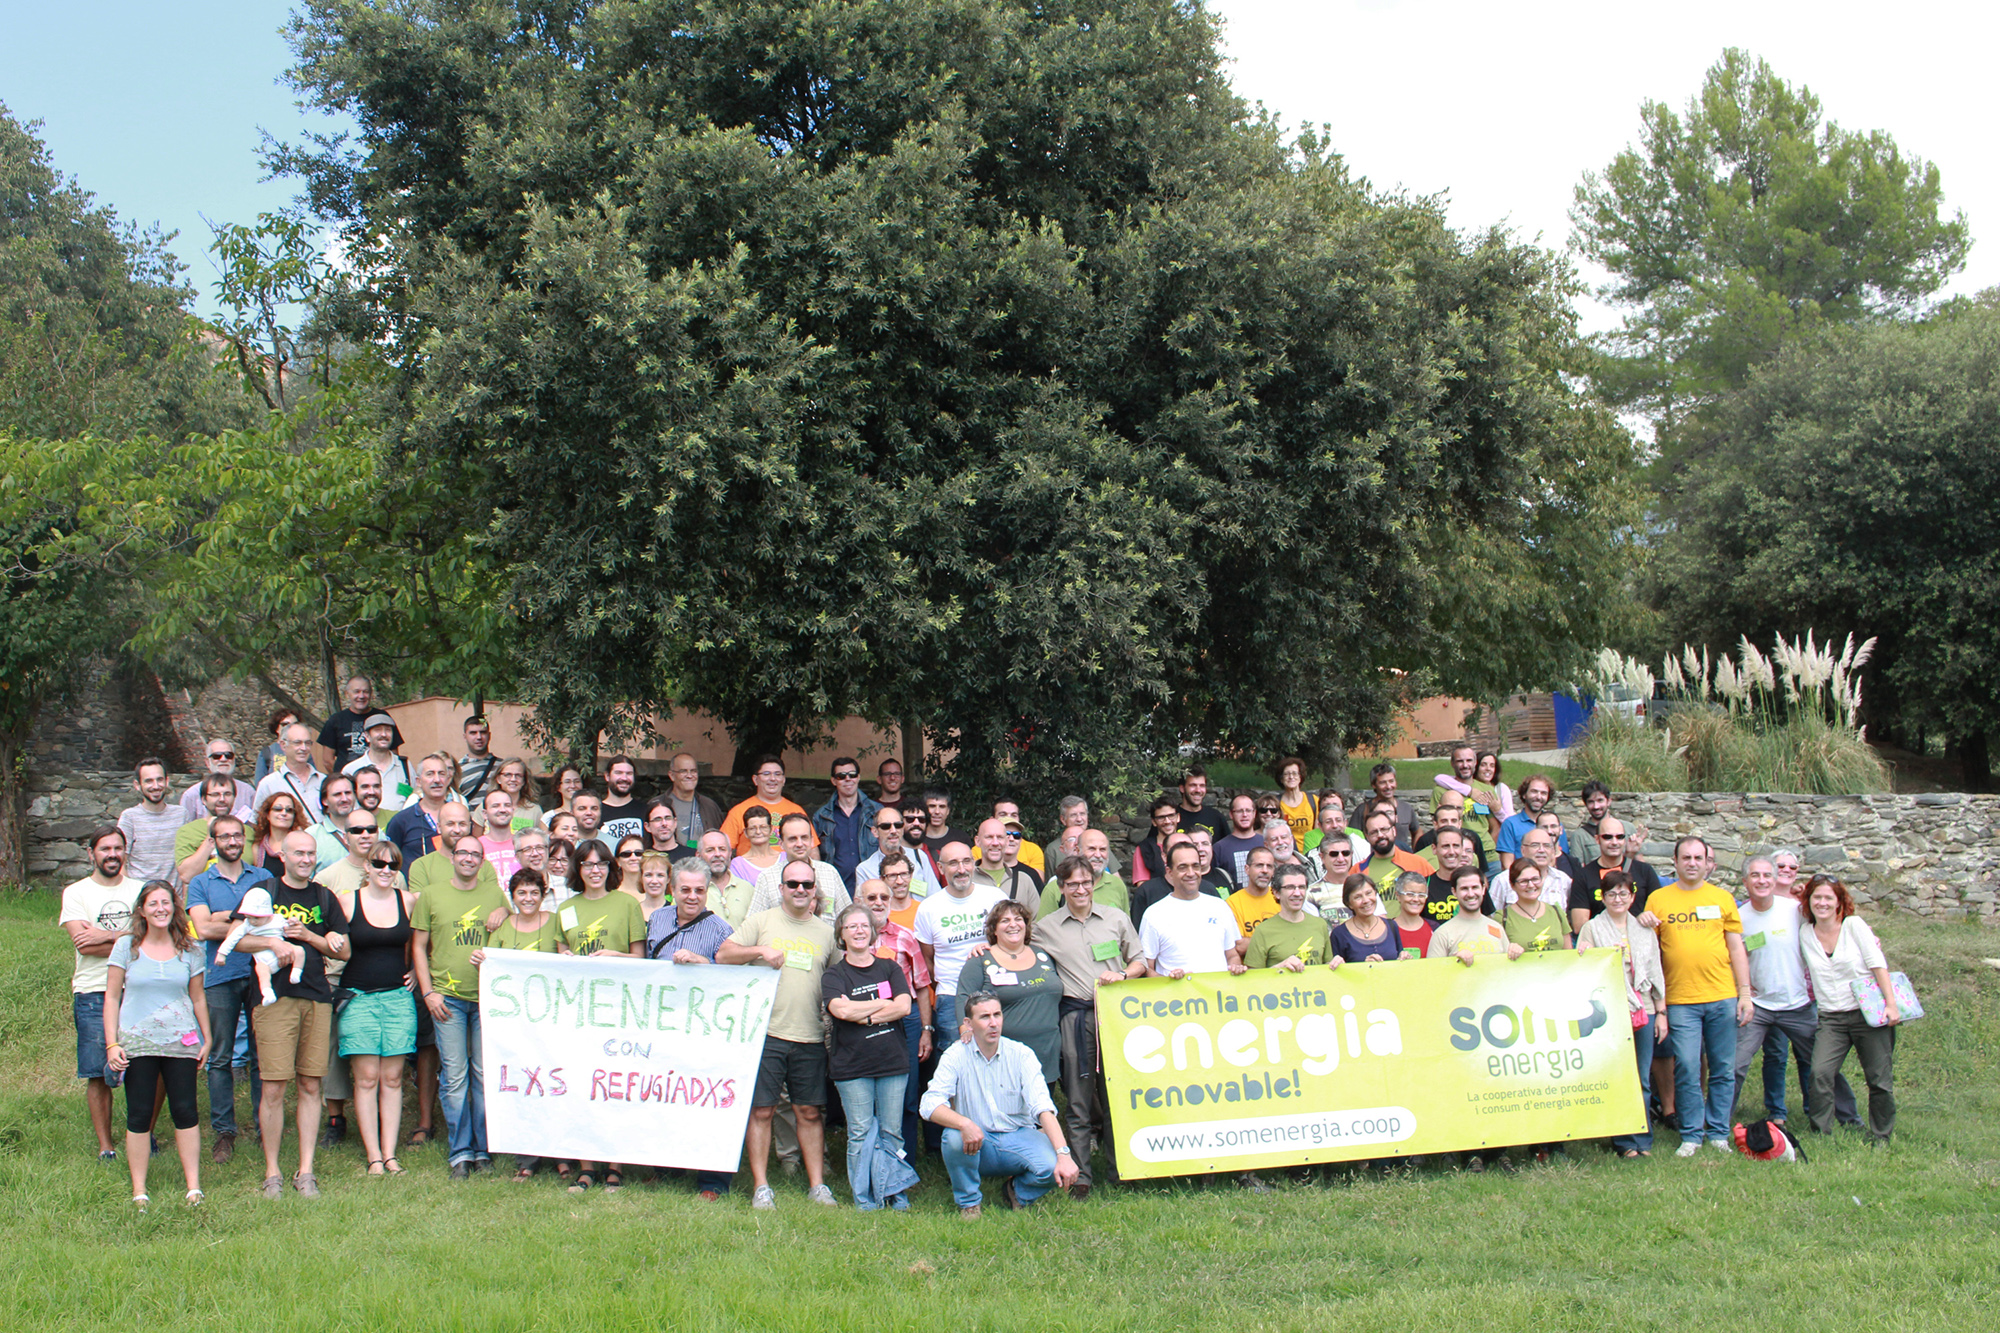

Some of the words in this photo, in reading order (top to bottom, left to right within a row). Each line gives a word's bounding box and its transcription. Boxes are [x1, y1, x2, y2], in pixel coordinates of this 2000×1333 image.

[1286, 818, 1308, 827] om
[1120, 995, 1208, 1019] Creem
[1217, 990, 1238, 1013] la
[1247, 987, 1327, 1012] nostra
[603, 1038, 652, 1058] CON
[1123, 994, 1403, 1076] energia
[1487, 1048, 1584, 1079] energia
[498, 1064, 568, 1097] LXS
[1130, 1069, 1302, 1110] renovable!
[1467, 1092, 1480, 1103] La
[1482, 1086, 1543, 1103] cooperativa
[1544, 1084, 1558, 1095] de
[1560, 1080, 1609, 1098] producció
[1482, 1103, 1521, 1115] consum
[1523, 1098, 1572, 1112] d'energia
[1574, 1095, 1605, 1106] verda.
[1146, 1117, 1401, 1152] www.somenergia.coop
